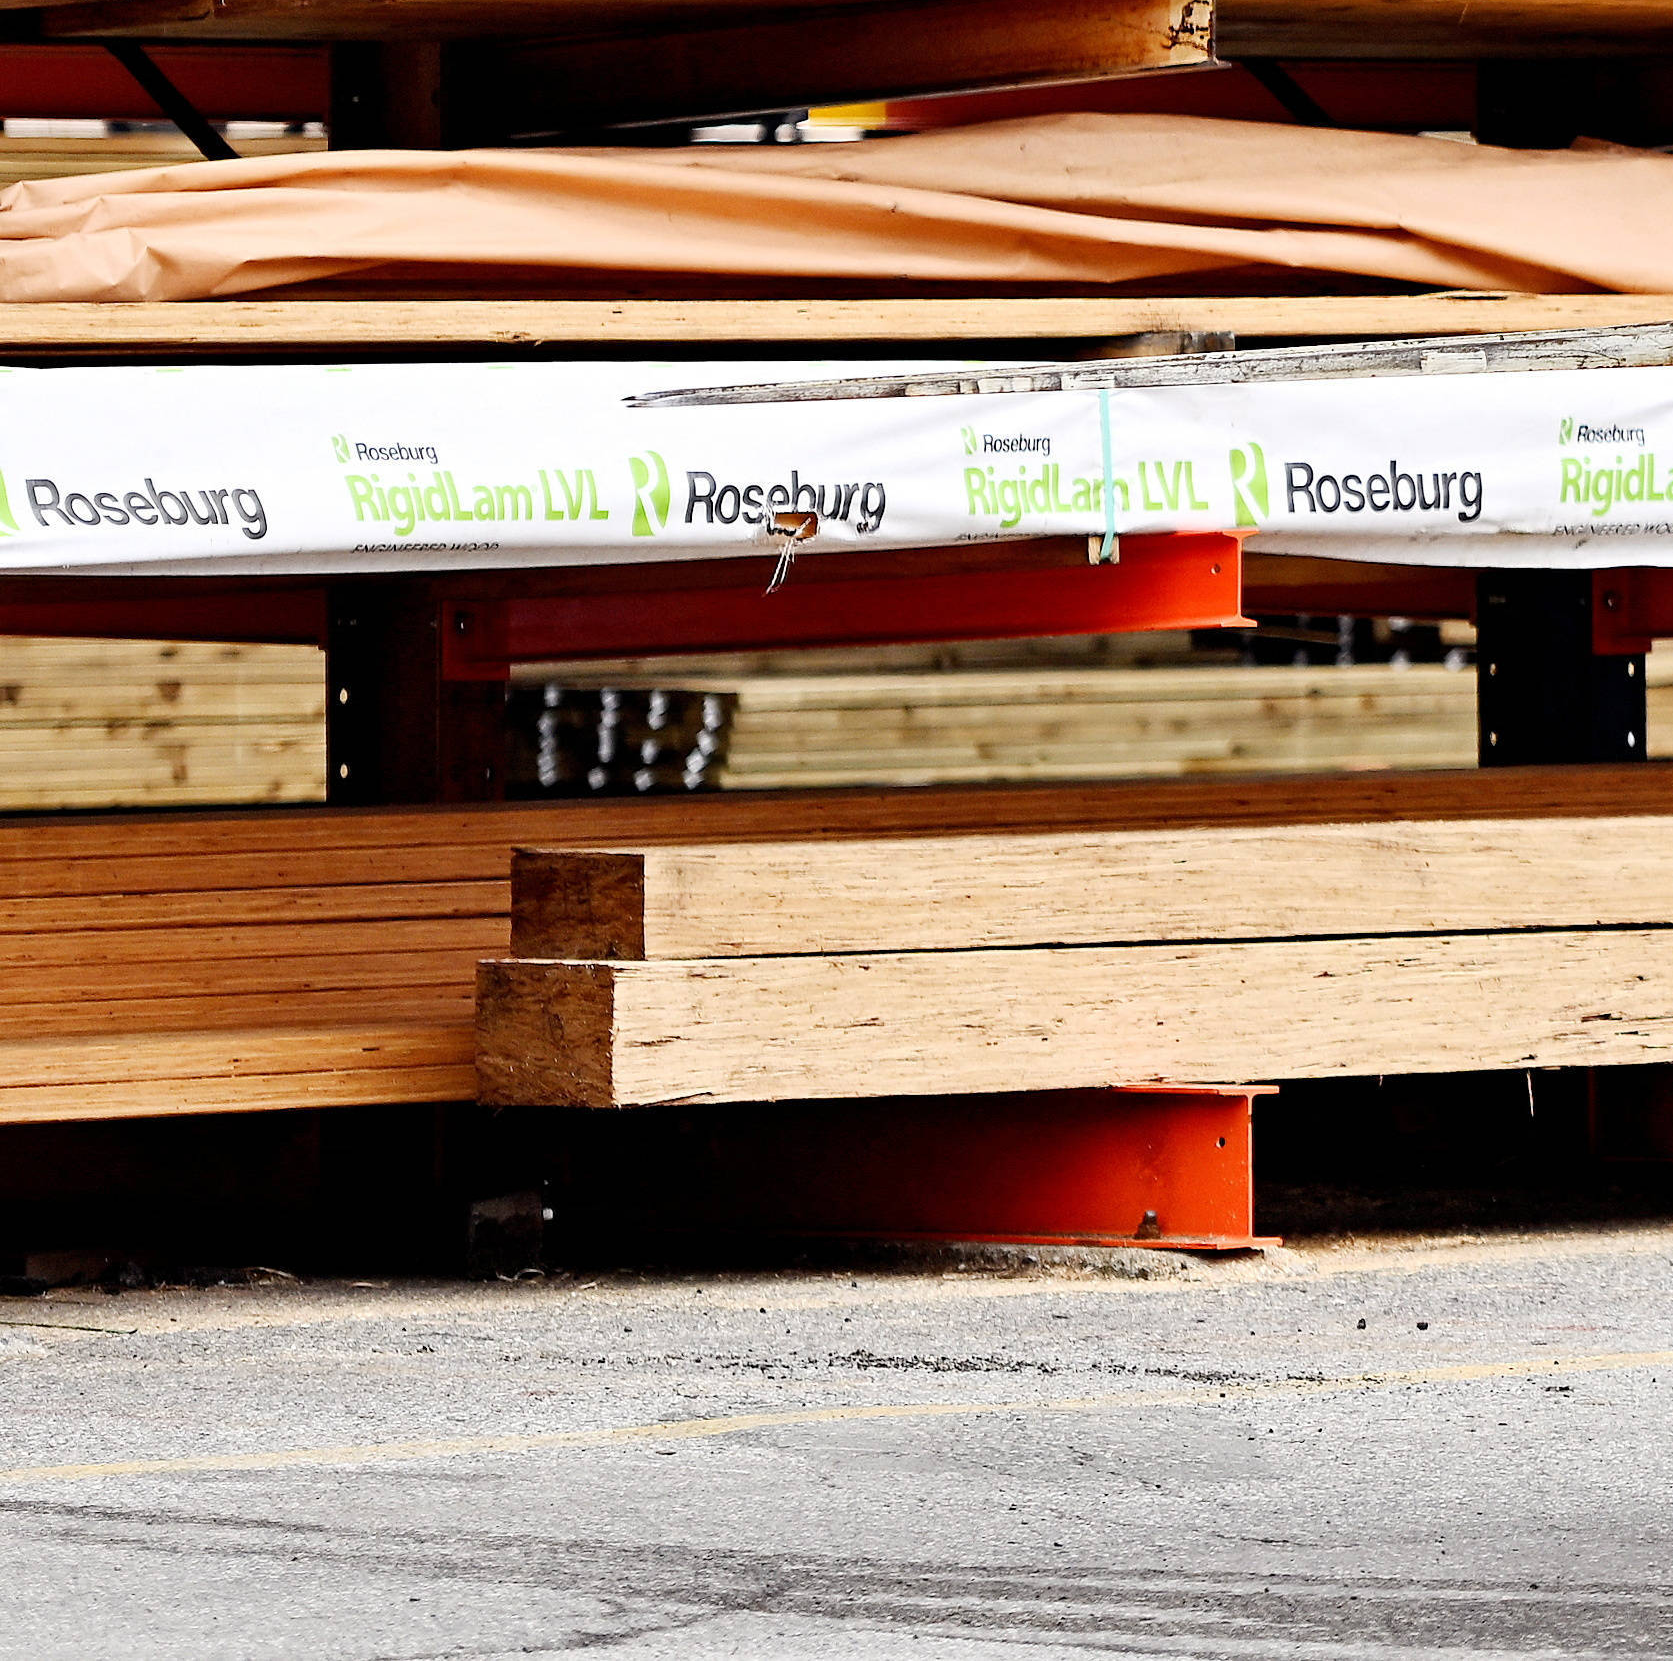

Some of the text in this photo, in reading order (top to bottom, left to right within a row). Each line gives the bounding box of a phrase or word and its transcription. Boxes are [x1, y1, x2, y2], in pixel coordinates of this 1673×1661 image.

[356, 442, 438, 465] Roseburg
[982, 433, 1050, 457] Roseburg
[25, 477, 268, 540] Roseburg
[344, 469, 609, 536] RigidLam LVL
[685, 470, 886, 535] Roseburg
[964, 460, 1209, 528] RigidLam LVL
[1285, 459, 1482, 523] Roseburg
